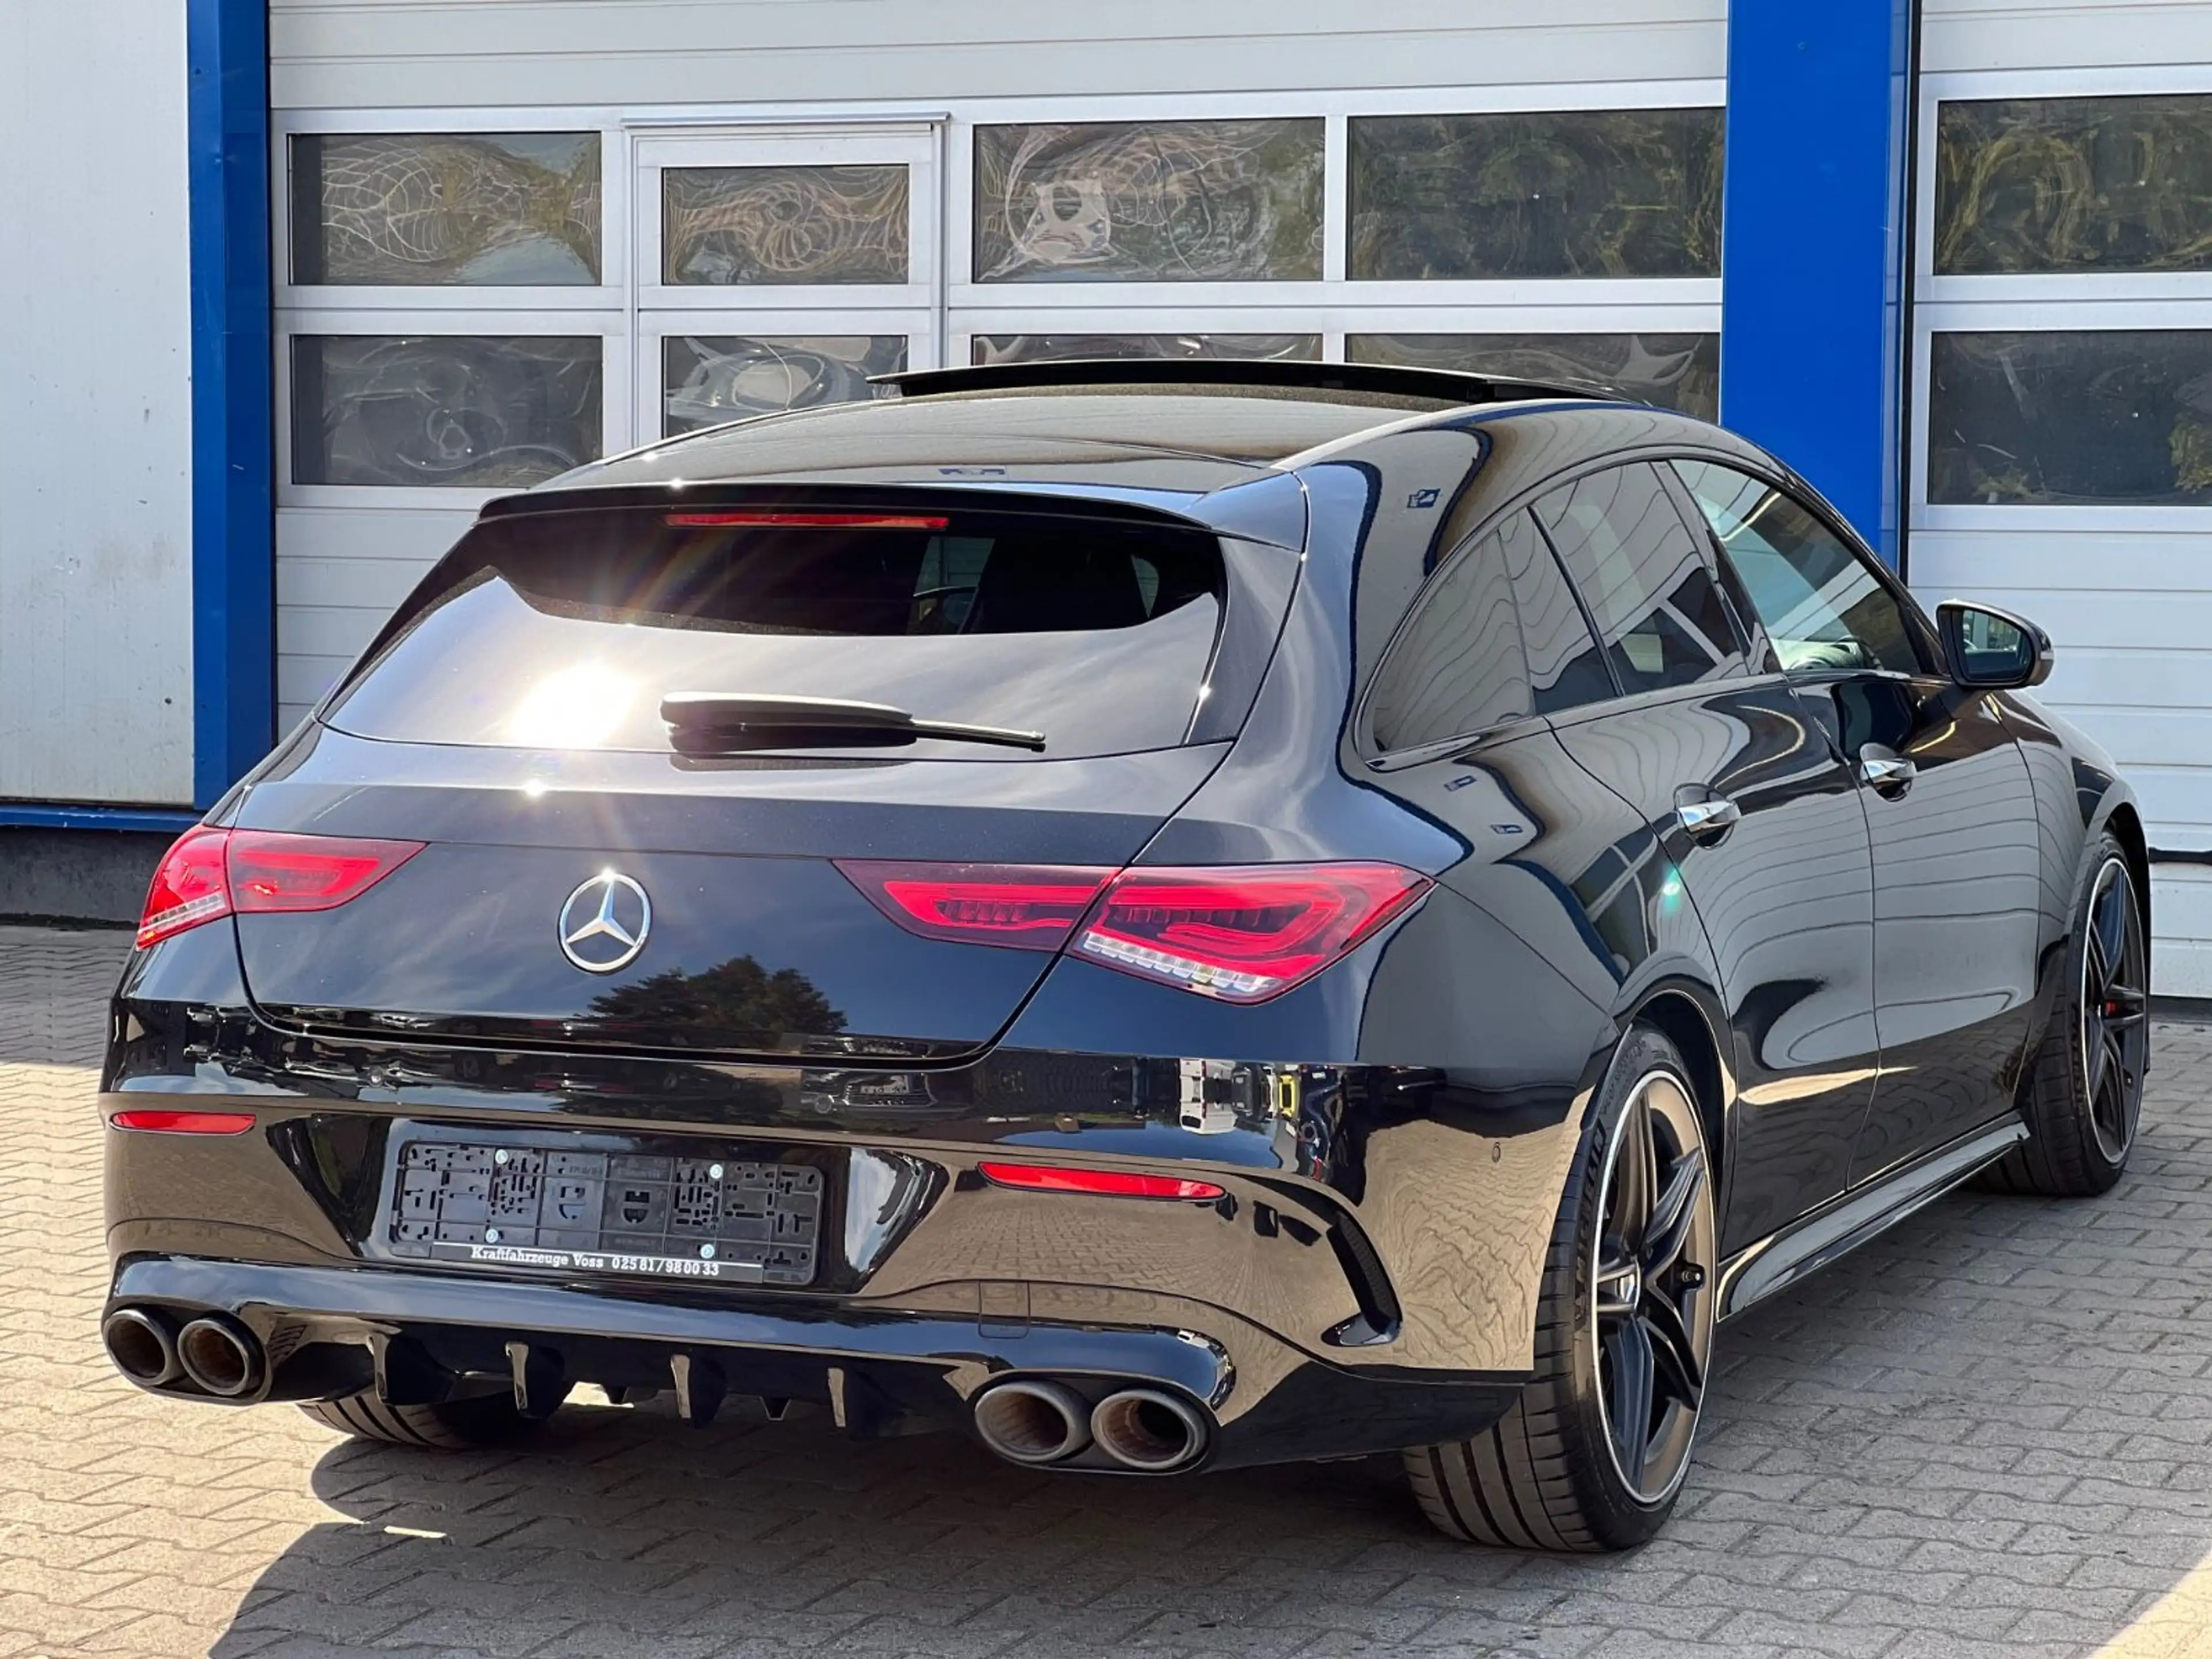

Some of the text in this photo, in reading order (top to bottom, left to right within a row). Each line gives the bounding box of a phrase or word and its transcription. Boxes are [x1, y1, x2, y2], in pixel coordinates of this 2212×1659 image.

[1575, 1126, 1605, 1285] MICHELIN
[471, 1246, 569, 1267] Kraftfahrzeuge
[572, 1252, 604, 1268] Voss
